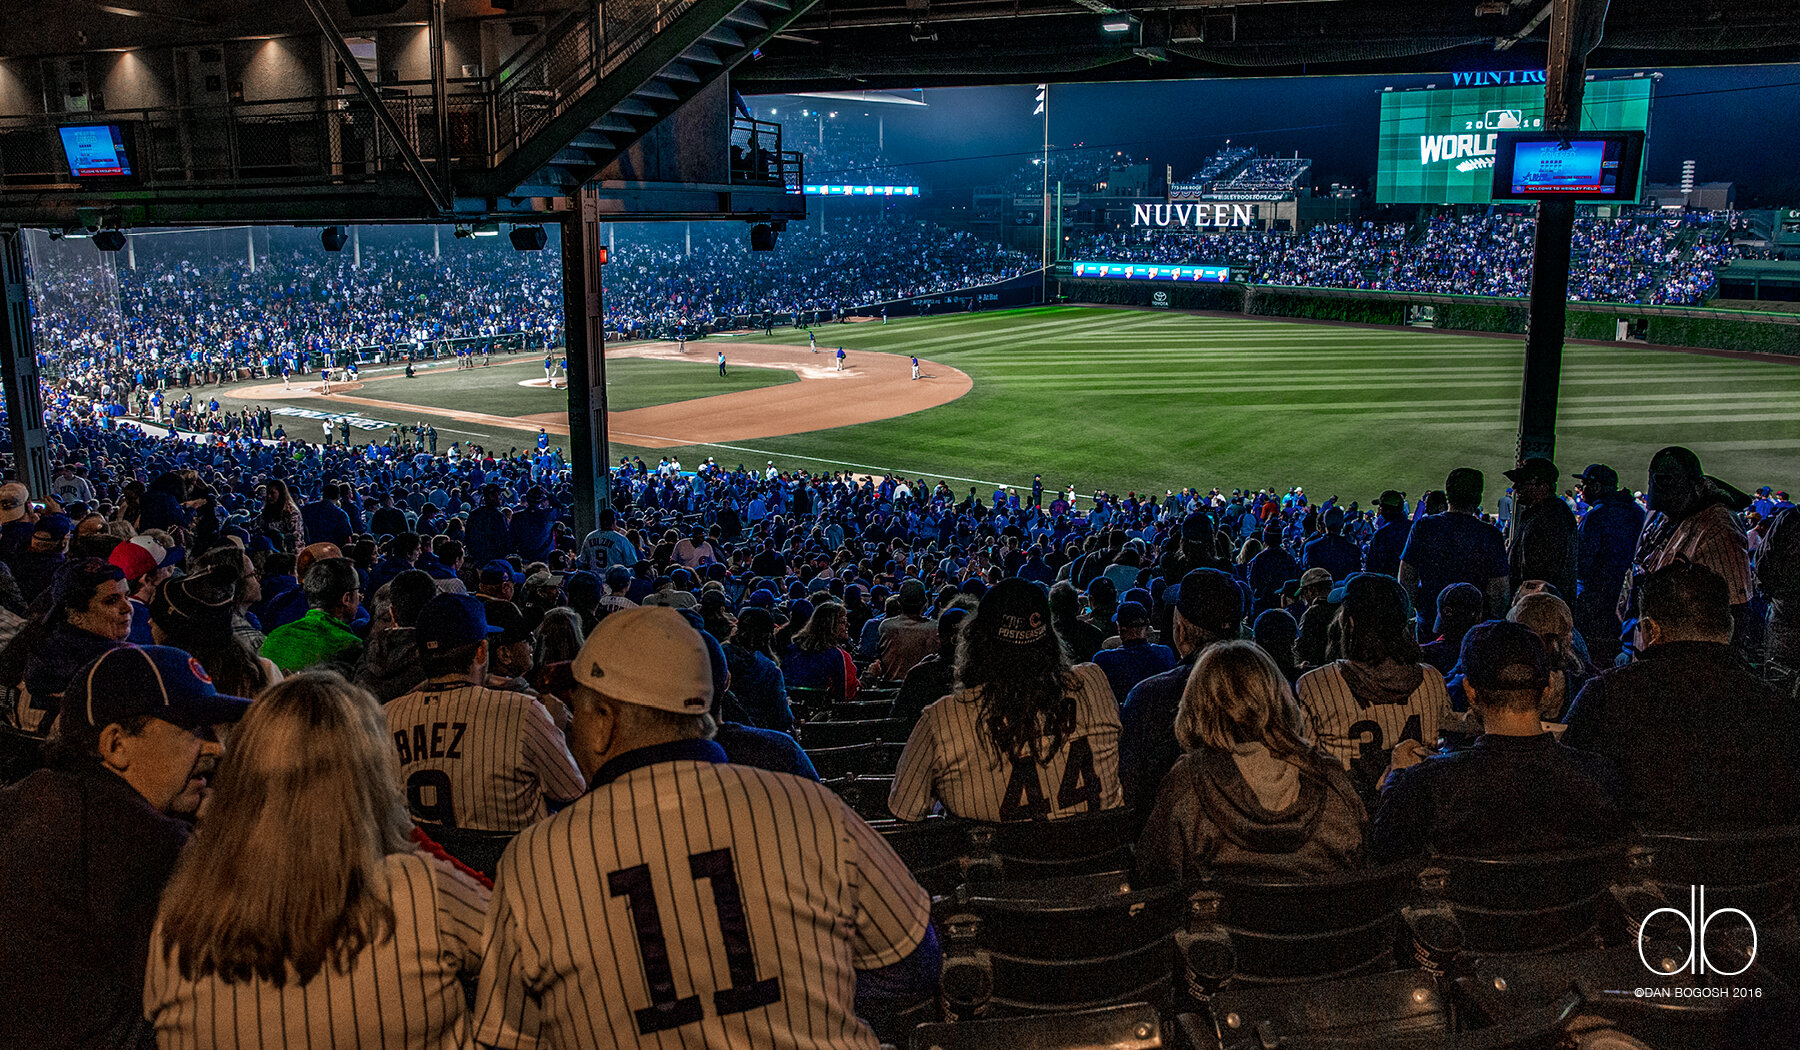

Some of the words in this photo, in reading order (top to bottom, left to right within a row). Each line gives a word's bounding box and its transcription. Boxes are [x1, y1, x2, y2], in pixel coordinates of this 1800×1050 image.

[1132, 203, 1253, 227] NUVEEN
[596, 549, 607, 567] 9
[393, 721, 467, 766] BAEZ
[406, 769, 456, 828] 9
[606, 846, 781, 1034] 11
